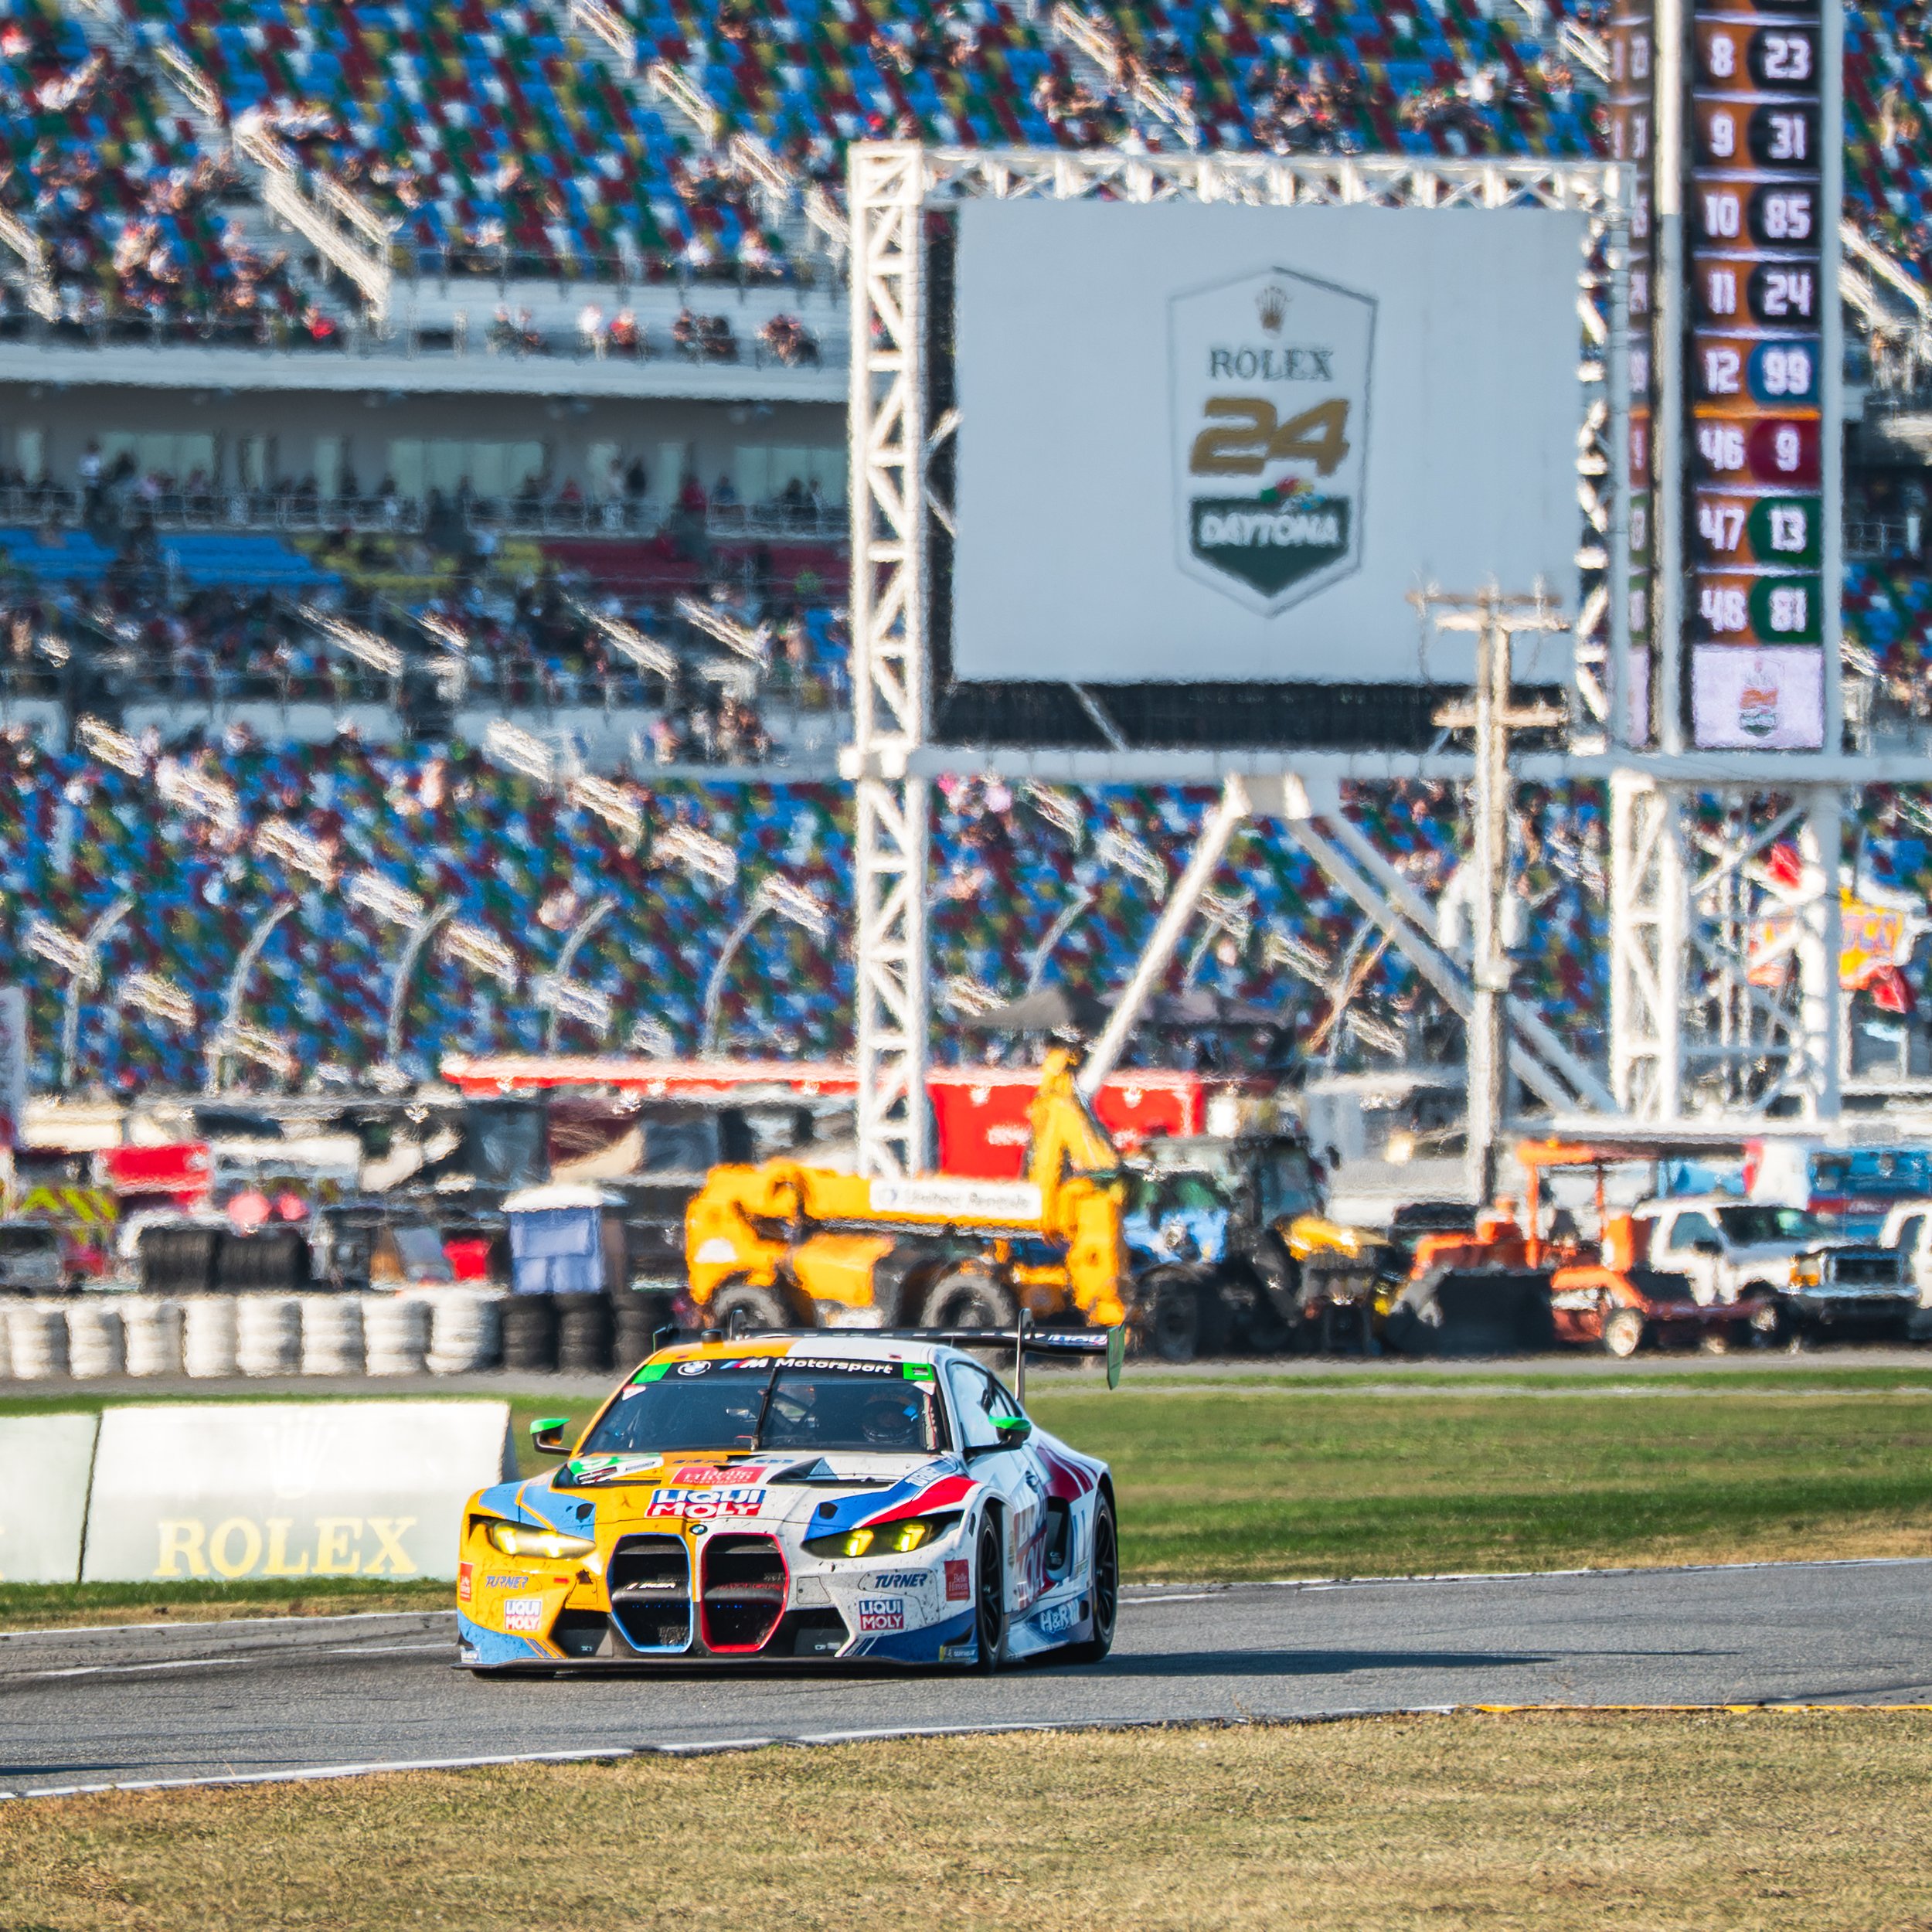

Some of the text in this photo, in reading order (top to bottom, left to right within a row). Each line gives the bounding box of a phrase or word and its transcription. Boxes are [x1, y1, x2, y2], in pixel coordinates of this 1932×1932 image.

[1710, 35, 1811, 80] 8 23
[1710, 113, 1806, 160] 9 31
[1705, 195, 1811, 240] 10 85
[1709, 269, 1811, 316] 11 24
[1209, 348, 1333, 382] ROLEX
[1705, 349, 1811, 395] 12 99
[1189, 397, 1351, 478] 24
[1701, 427, 1801, 471] 46 9
[1199, 512, 1340, 549] DAYTONA
[1701, 507, 1807, 552] 47 13
[1701, 588, 1747, 632] 48
[774, 1358, 893, 1375] Motorsport
[651, 1503, 756, 1519] MOLY
[657, 1489, 763, 1505] LIQUI
[155, 1516, 419, 1577] ROLEX
[485, 1576, 529, 1589] TURNER
[875, 1573, 928, 1589] TURNER
[505, 1600, 541, 1615] LIQUI
[505, 1615, 539, 1630] MOLY
[860, 1600, 902, 1614] LIQUI
[862, 1615, 903, 1630] MOLY
[1040, 1604, 1070, 1632] H&R
